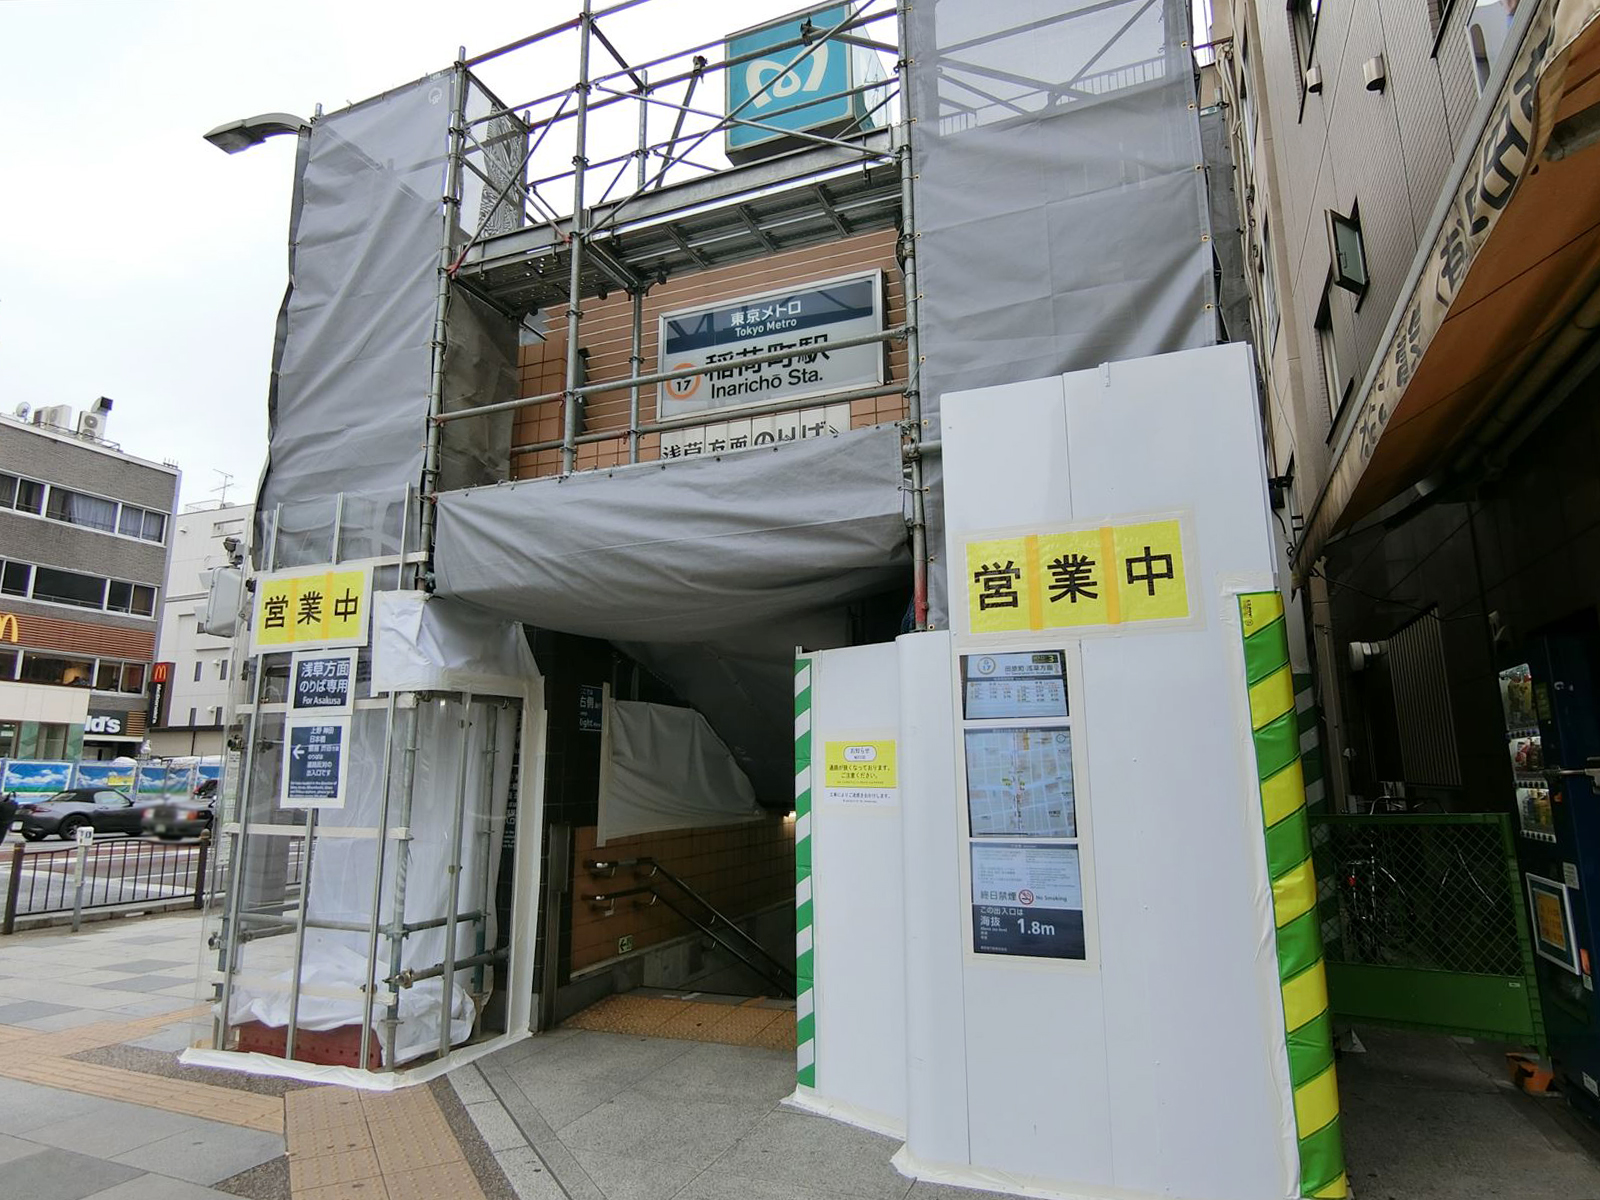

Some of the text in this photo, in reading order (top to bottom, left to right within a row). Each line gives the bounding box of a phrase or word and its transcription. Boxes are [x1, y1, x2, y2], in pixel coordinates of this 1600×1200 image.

[730, 300, 802, 327] 東京メトロ
[735, 318, 798, 338] Tokyo Metro
[676, 379, 692, 392] 17
[711, 367, 824, 399] Inarichō Sta.
[974, 546, 1174, 611] 営業中
[264, 588, 358, 630] 営業中
[301, 660, 350, 678] 浅草方面
[300, 679, 349, 694] のりば専用
[302, 696, 341, 705] For Asakusa
[980, 906, 1024, 916] この出入口は
[980, 915, 1001, 927] 海抜
[1017, 918, 1055, 936] 1.8m
